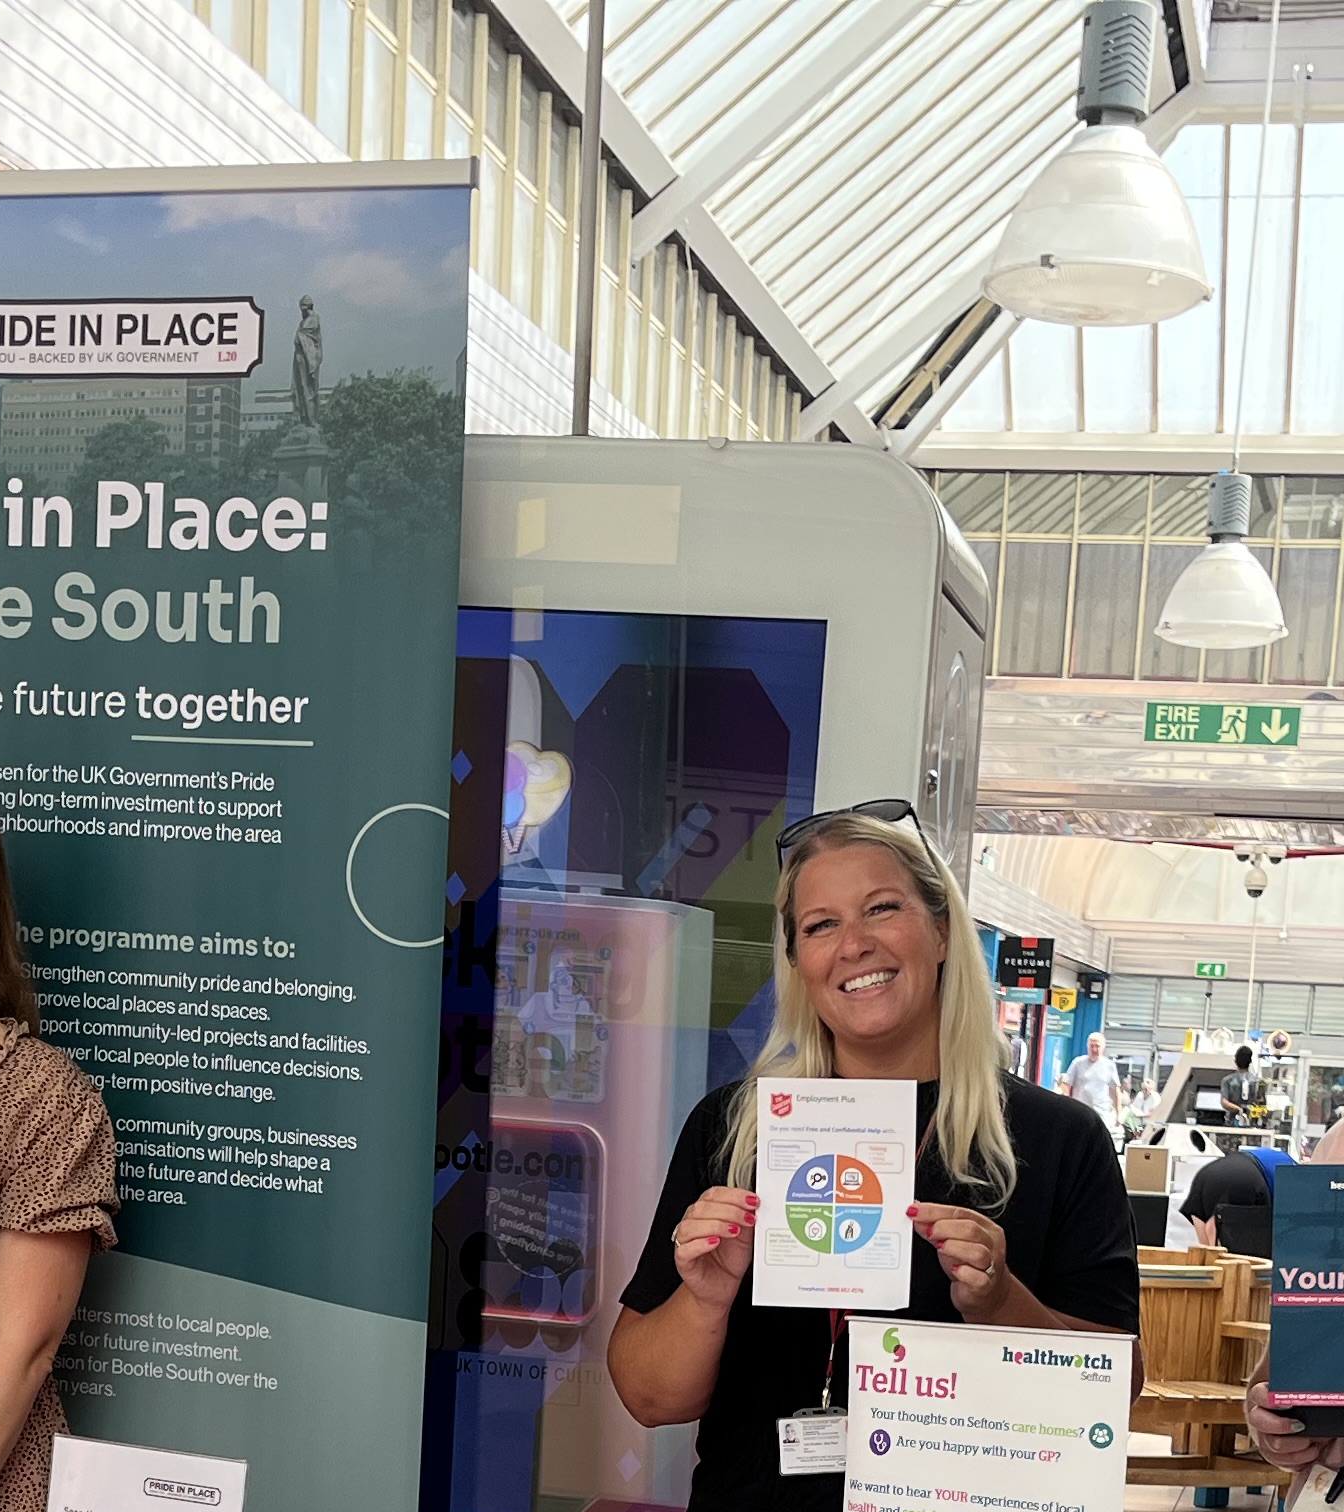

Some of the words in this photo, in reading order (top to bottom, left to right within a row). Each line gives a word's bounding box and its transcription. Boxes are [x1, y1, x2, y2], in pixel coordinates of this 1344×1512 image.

[69, 313, 102, 346] IN
[115, 313, 239, 345] PLACE
[28, 353, 76, 365] BACKED
[77, 353, 95, 365] BY
[96, 353, 114, 364] UK
[116, 352, 199, 364] GOVERNMENT
[216, 351, 238, 363] L20
[4, 478, 73, 548] in
[96, 481, 329, 552] Place:
[51, 572, 281, 644] South
[12, 681, 126, 718] future
[136, 688, 309, 728] together
[1155, 706, 1200, 722] FIRE
[1154, 724, 1200, 741] EXIT
[27, 765, 50, 783] for
[52, 765, 78, 784] the
[81, 766, 107, 786] UK
[109, 766, 229, 790] Government's
[231, 771, 275, 792] Pride
[19, 789, 98, 812] long-term
[101, 792, 195, 815] investment
[198, 796, 215, 816] to
[218, 799, 283, 820] support
[108, 819, 141, 837] and
[143, 820, 213, 842] improve
[215, 824, 242, 843] the
[245, 828, 282, 844] area
[49, 925, 195, 954] programme
[199, 931, 258, 957] aims
[262, 936, 296, 959] to:
[107, 969, 198, 996] community
[200, 974, 241, 993] pride
[243, 977, 272, 994] and
[274, 979, 357, 1003] belonging.
[94, 1045, 131, 1065] local
[134, 1049, 189, 1070] people
[192, 1051, 208, 1069] to
[211, 1052, 281, 1076] influence
[283, 1057, 364, 1081] decisions.
[477, 1360, 523, 1378] TOWN
[529, 1365, 548, 1380] OF
[554, 1367, 611, 1386] CULTU
[1002, 1347, 1113, 1371] healthwatch
[856, 1365, 907, 1395] Tell
[915, 1372, 958, 1399] us!
[1080, 1371, 1112, 1383] Sefton
[870, 1407, 895, 1421] Your
[898, 1410, 947, 1428] thoughts
[949, 1416, 965, 1427] on
[1011, 1422, 1037, 1434] care
[1038, 1423, 1086, 1439] homes?
[896, 1436, 917, 1448] Are
[919, 1440, 940, 1454] you
[943, 1440, 979, 1457] happy
[981, 1444, 1007, 1458] with
[1009, 1448, 1036, 1462] your
[1038, 1450, 1061, 1463] GP?
[149, 1481, 174, 1493] PRIDE
[176, 1485, 185, 1494] IN
[187, 1487, 216, 1499] PLACE
[849, 1479, 863, 1491] We
[864, 1483, 890, 1495] want
[892, 1485, 904, 1496] to
[906, 1486, 932, 1499] hear
[934, 1488, 968, 1503] YOUR
[970, 1494, 1040, 1512] experiences
[1041, 1500, 1054, 1512] of
